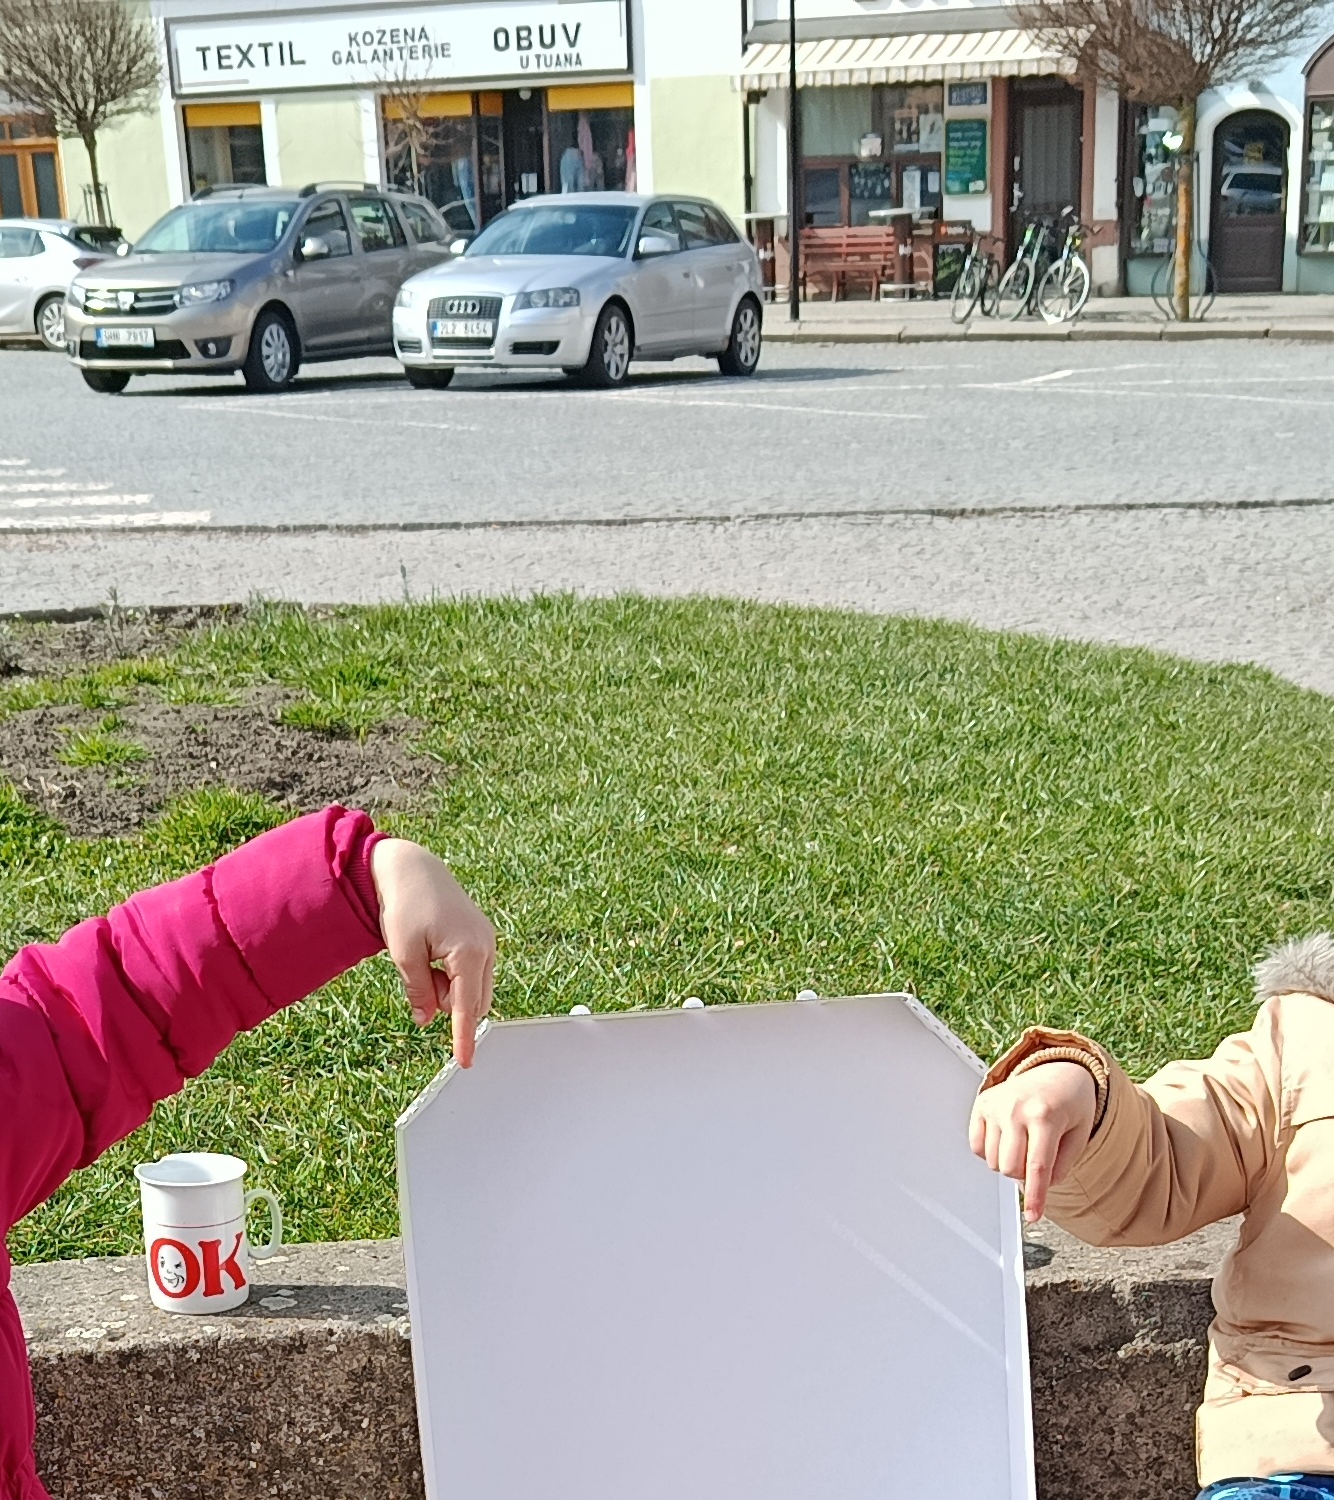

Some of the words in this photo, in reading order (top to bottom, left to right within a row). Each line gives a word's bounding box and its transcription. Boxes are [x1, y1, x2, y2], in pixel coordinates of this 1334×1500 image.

[493, 22, 582, 51] OBUV
[196, 41, 306, 71] TEXTIL
[331, 42, 451, 66] GALANTERIE
[519, 54, 530, 70] U
[150, 1231, 247, 1299] OK
